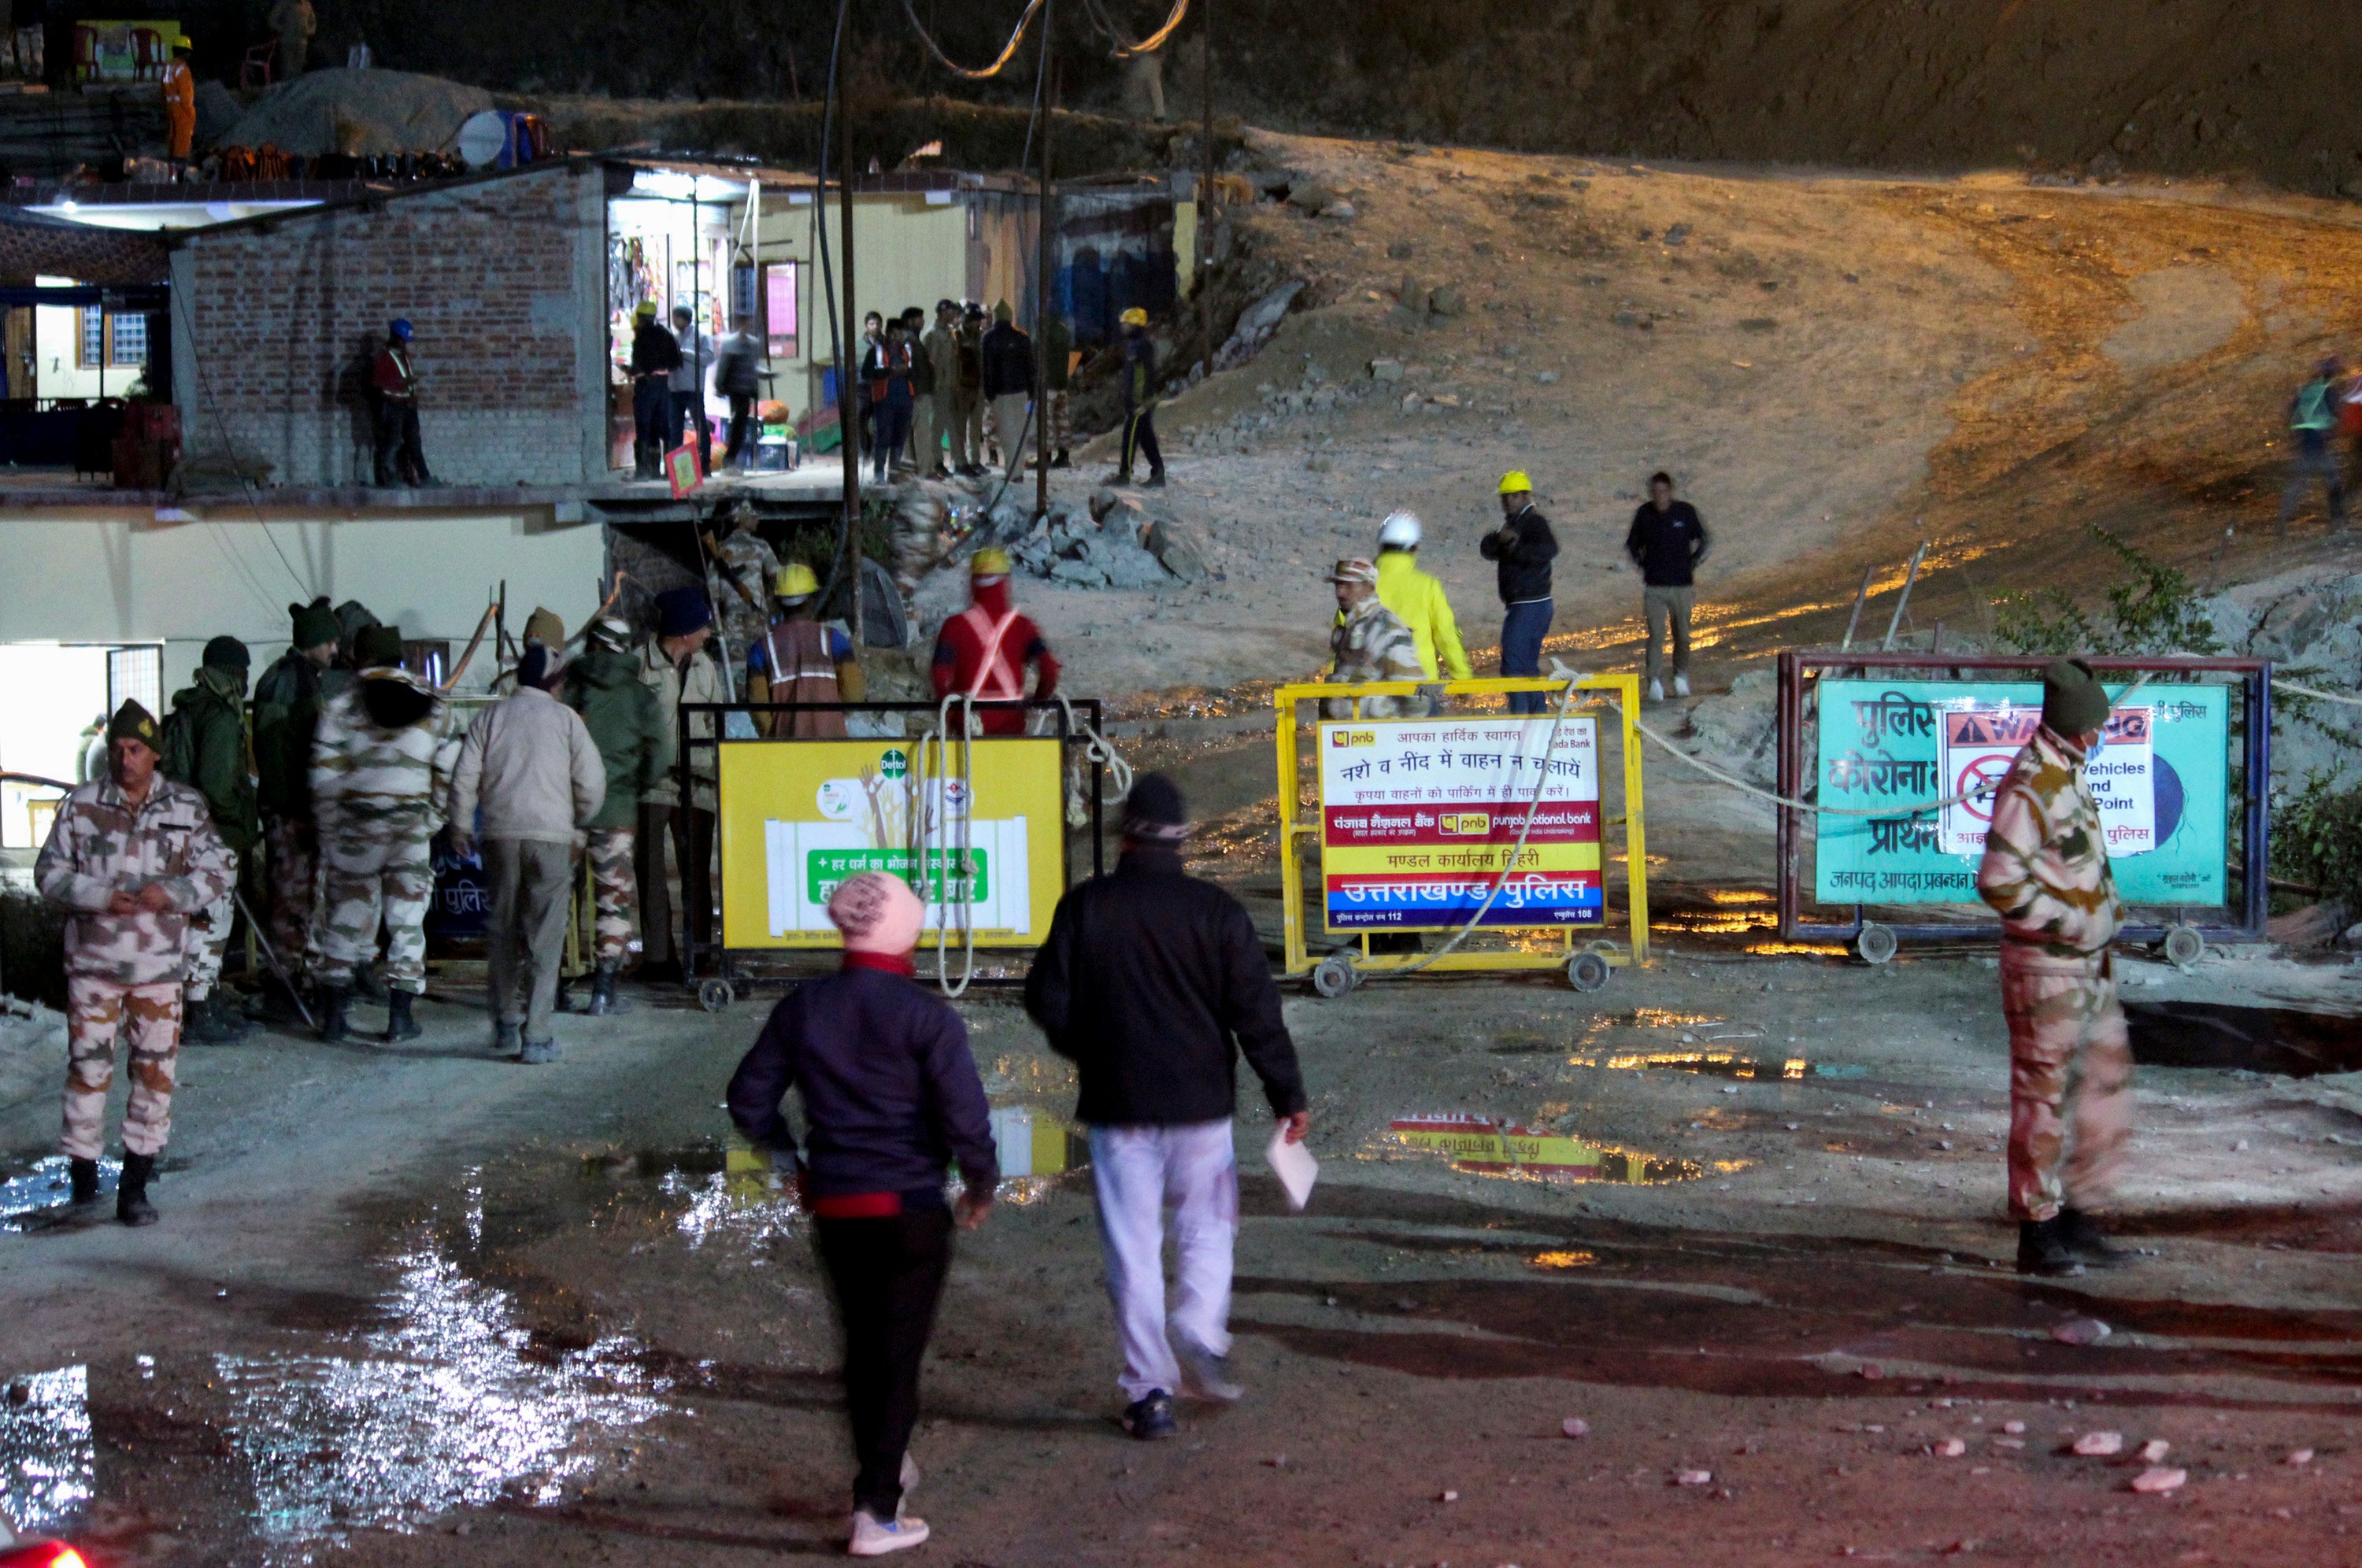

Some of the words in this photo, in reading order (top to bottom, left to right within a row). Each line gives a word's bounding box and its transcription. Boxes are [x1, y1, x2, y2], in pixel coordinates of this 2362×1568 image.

[1351, 733, 1374, 745] pnb
[1398, 732, 1436, 743] आपका
[1441, 728, 1478, 743] हार्दिक
[1483, 730, 1521, 741] स्वागत
[1570, 738, 1590, 749] Bank
[881, 760, 905, 770] Dettol
[1340, 759, 1372, 782] नशे
[1378, 760, 1391, 775] व
[1398, 750, 1431, 771] नींद
[1438, 749, 1453, 768] में
[1460, 753, 1503, 770] वाहन
[1509, 754, 1524, 770] न
[1827, 749, 1929, 796] कोरोना
[1354, 790, 1386, 803] कृपया
[1390, 786, 1423, 800] वाहनों
[1427, 786, 1443, 799] को
[1486, 785, 1497, 798] में
[1501, 783, 1513, 799] ही
[1334, 816, 1368, 829] पंजाब
[1461, 816, 1486, 831] pnb
[1493, 813, 1526, 829] punjab
[1530, 812, 1567, 825] ational
[1567, 811, 1591, 824] bank
[2107, 825, 2149, 845] पुलिस
[831, 858, 846, 871] हर
[849, 854, 867, 871] धर्म
[1386, 854, 1431, 867] मण्डल
[1437, 849, 1495, 867] कार्यालय
[1341, 880, 1490, 903] उत्तराखण्ड
[1501, 874, 1587, 908] पुलिस
[1830, 871, 1876, 894] जनपद
[1879, 871, 1921, 893] आपदा
[1388, 912, 1402, 921] 112
[1578, 909, 1592, 919] 108
